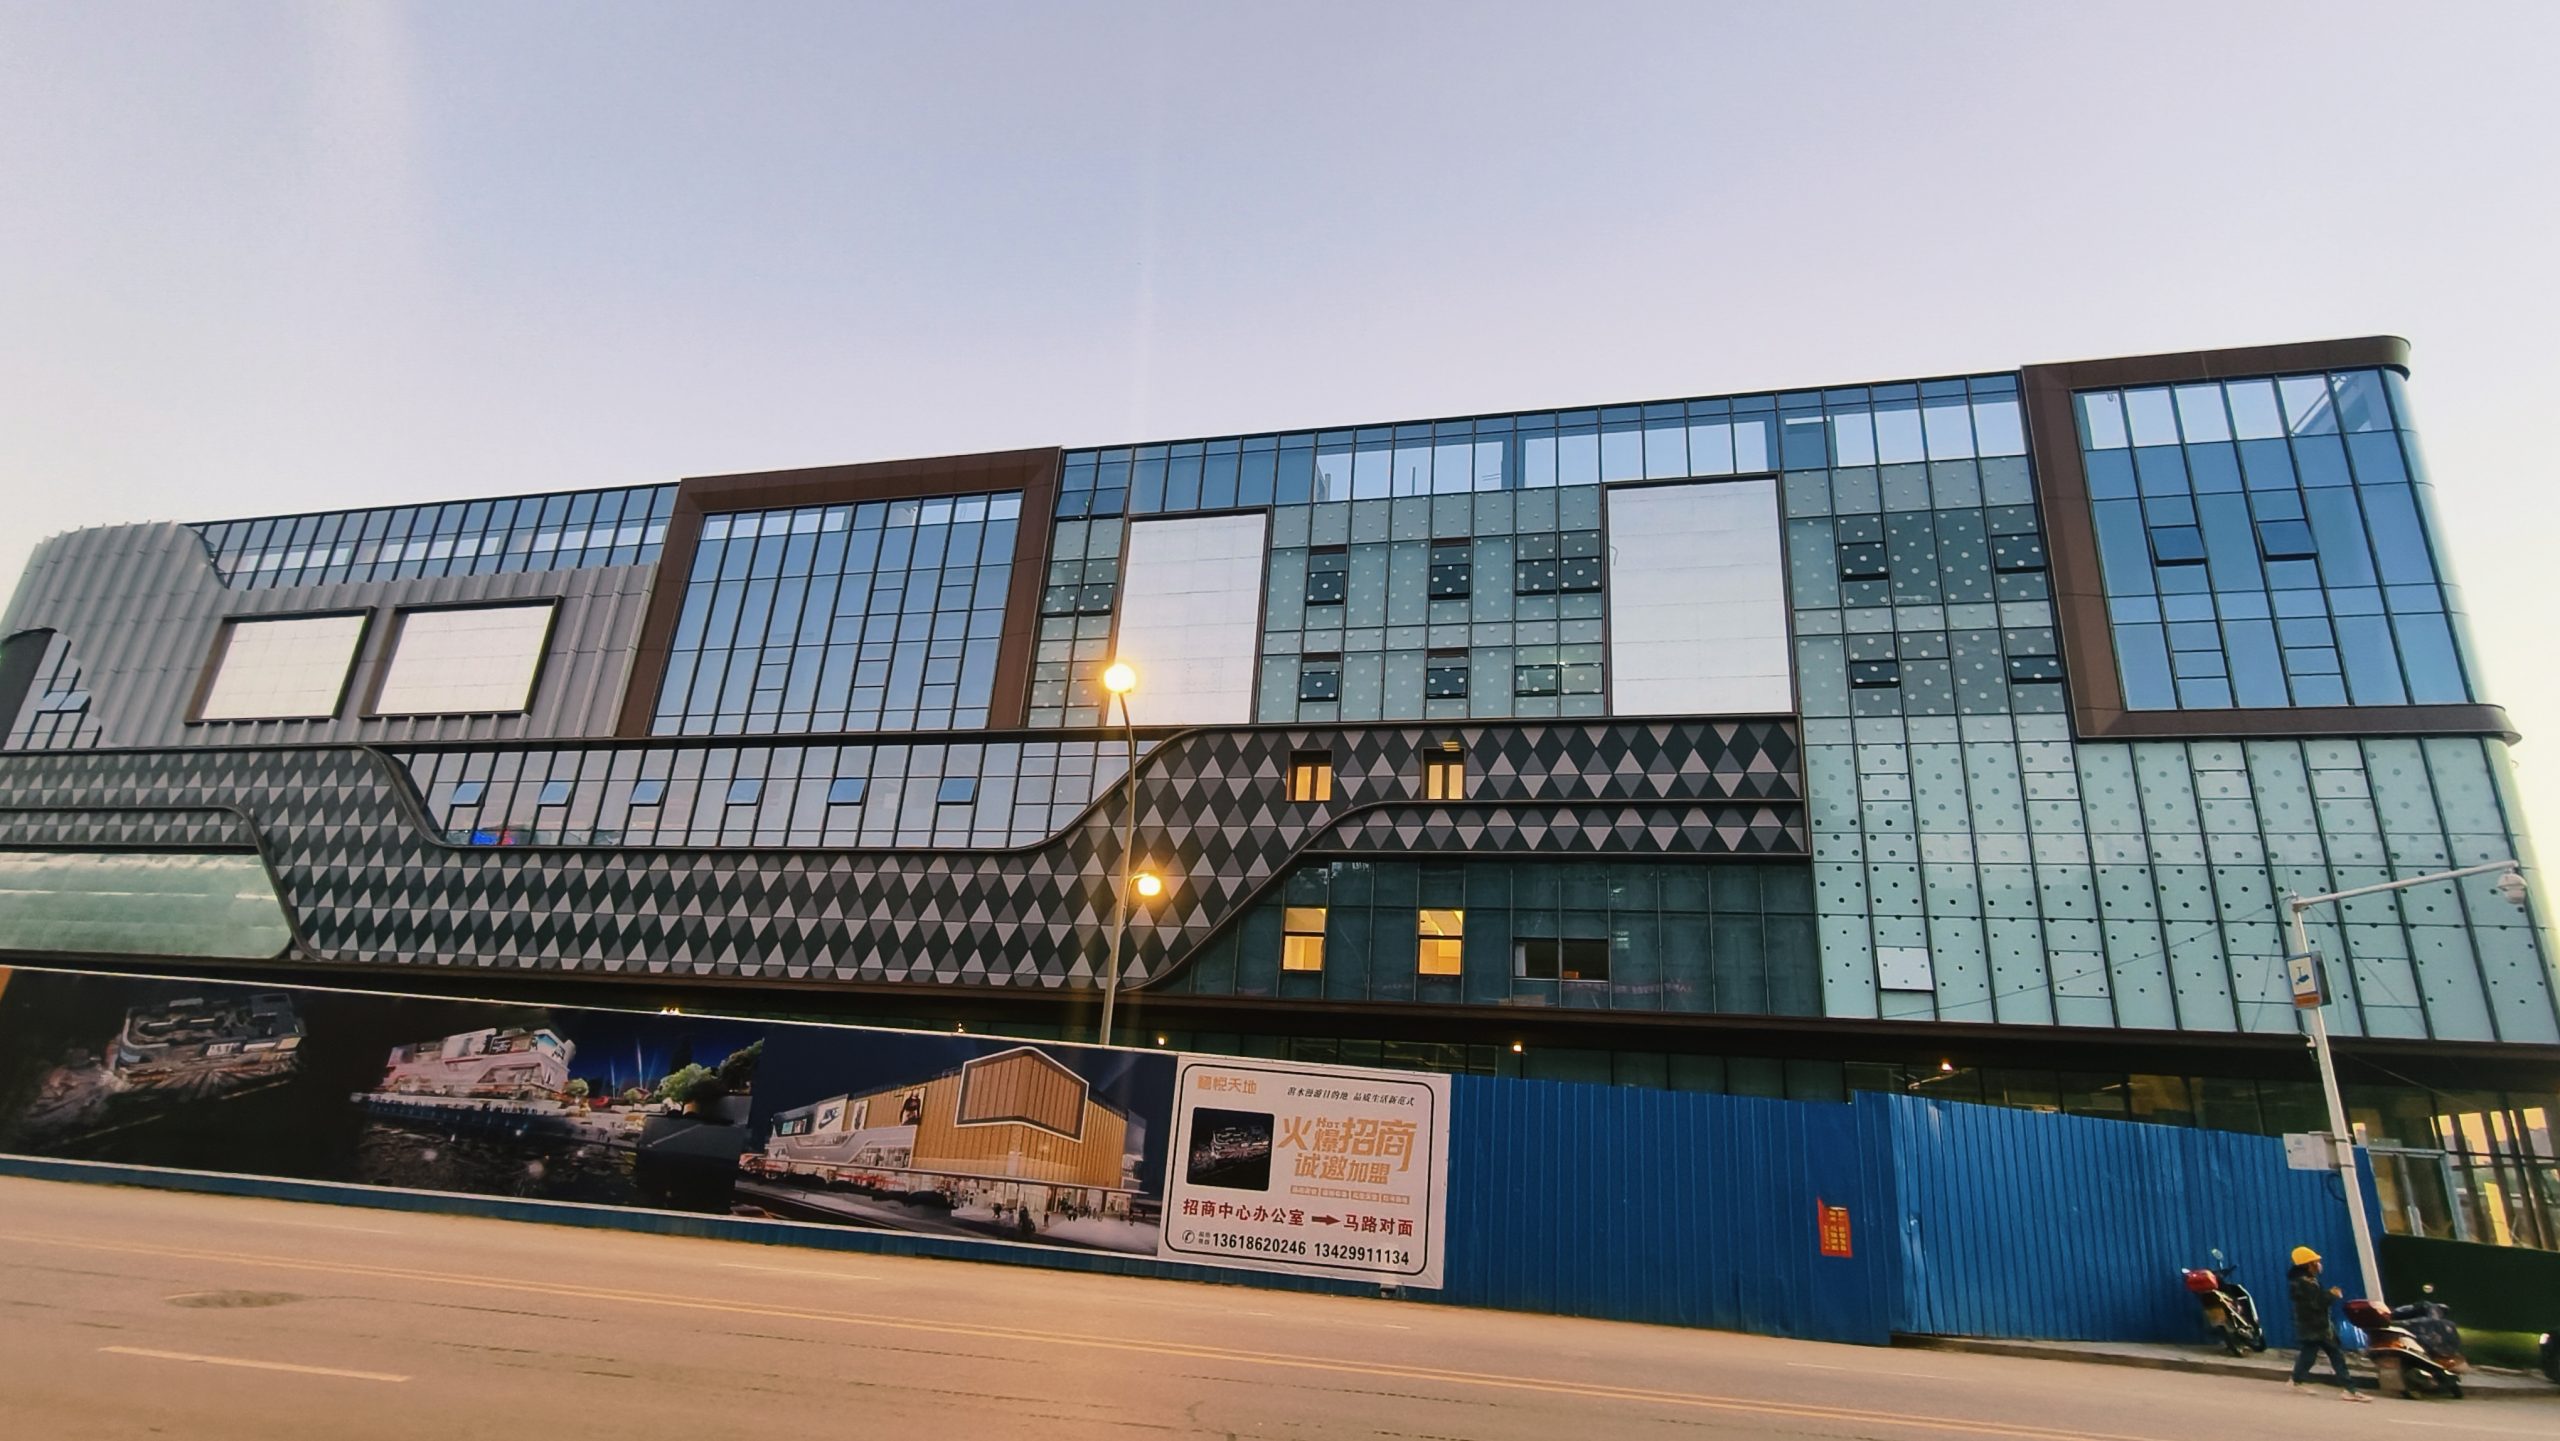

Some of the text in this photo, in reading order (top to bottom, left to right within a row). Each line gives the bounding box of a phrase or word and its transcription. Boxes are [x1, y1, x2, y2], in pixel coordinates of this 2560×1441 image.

[1277, 1116, 1418, 1172] 火爆招商
[1294, 1152, 1391, 1185] 诚邀加盟
[1182, 1198, 1414, 1237] 招商中心办公室 马路对面
[1212, 1232, 1307, 1256] 13618620246
[1314, 1242, 1410, 1266] 13429911134
